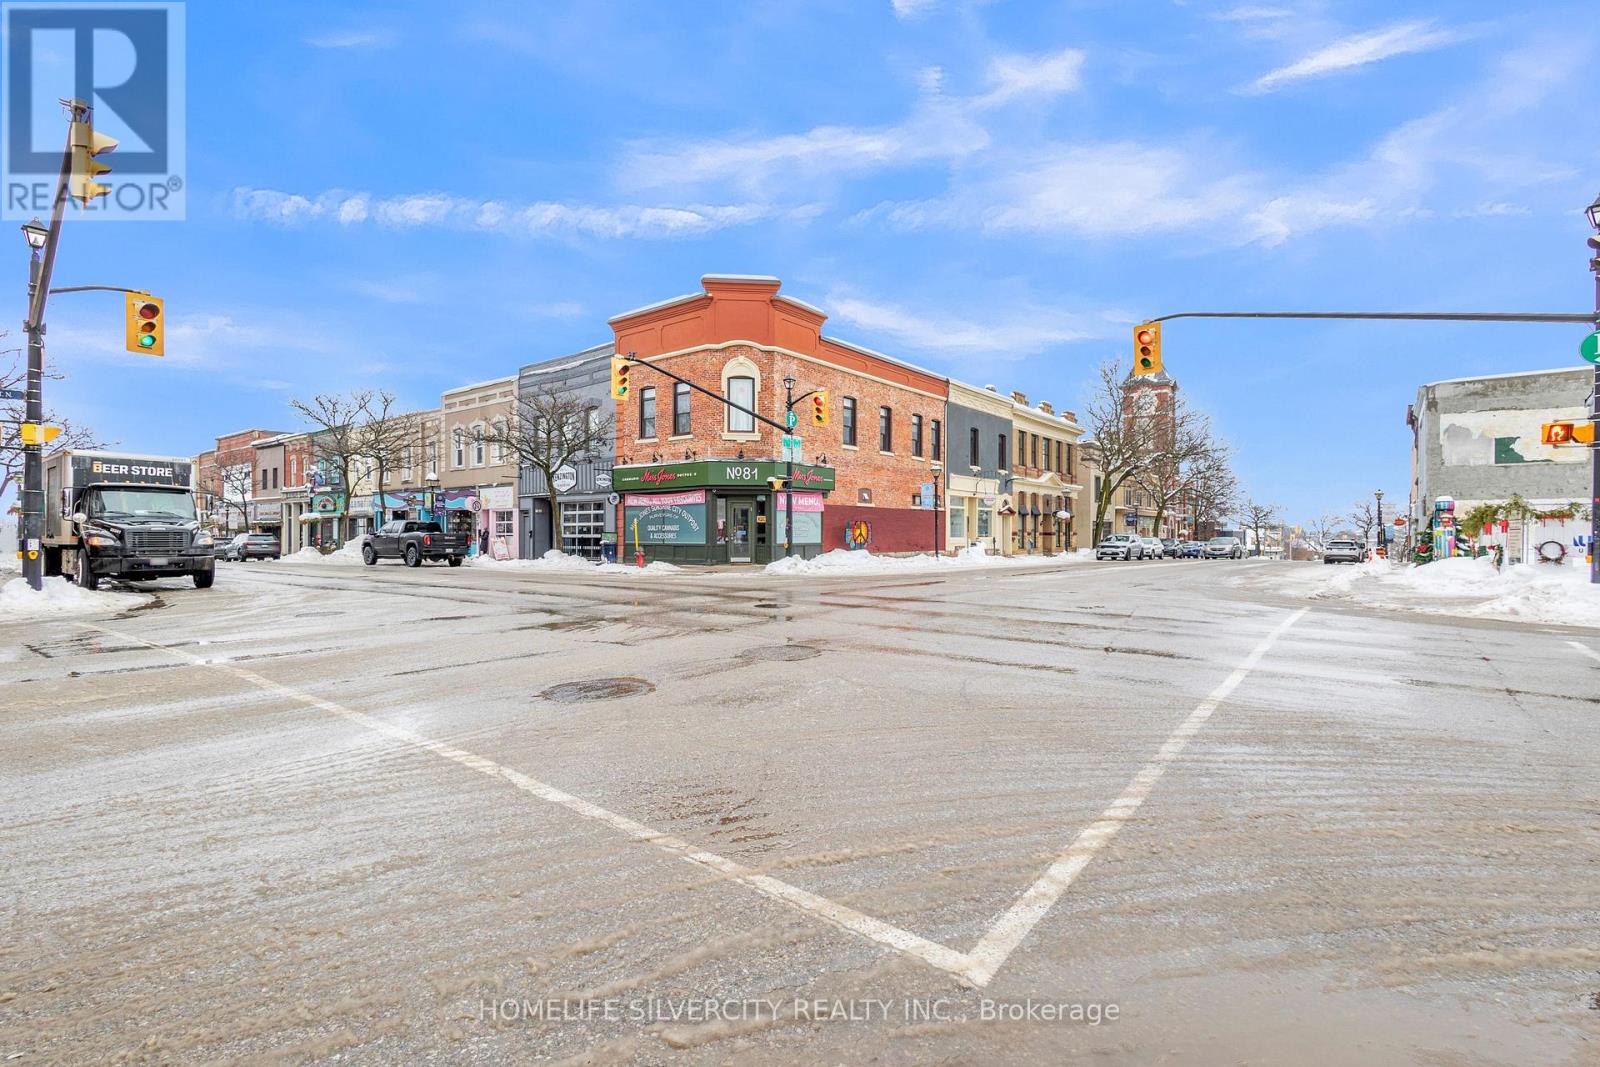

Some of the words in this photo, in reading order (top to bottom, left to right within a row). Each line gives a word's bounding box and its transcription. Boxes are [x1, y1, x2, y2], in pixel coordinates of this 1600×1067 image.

[93, 462, 128, 475] BEER
[131, 465, 173, 477] STORE
[672, 505, 682, 514] CITY
[681, 510, 700, 532] OUTPOST
